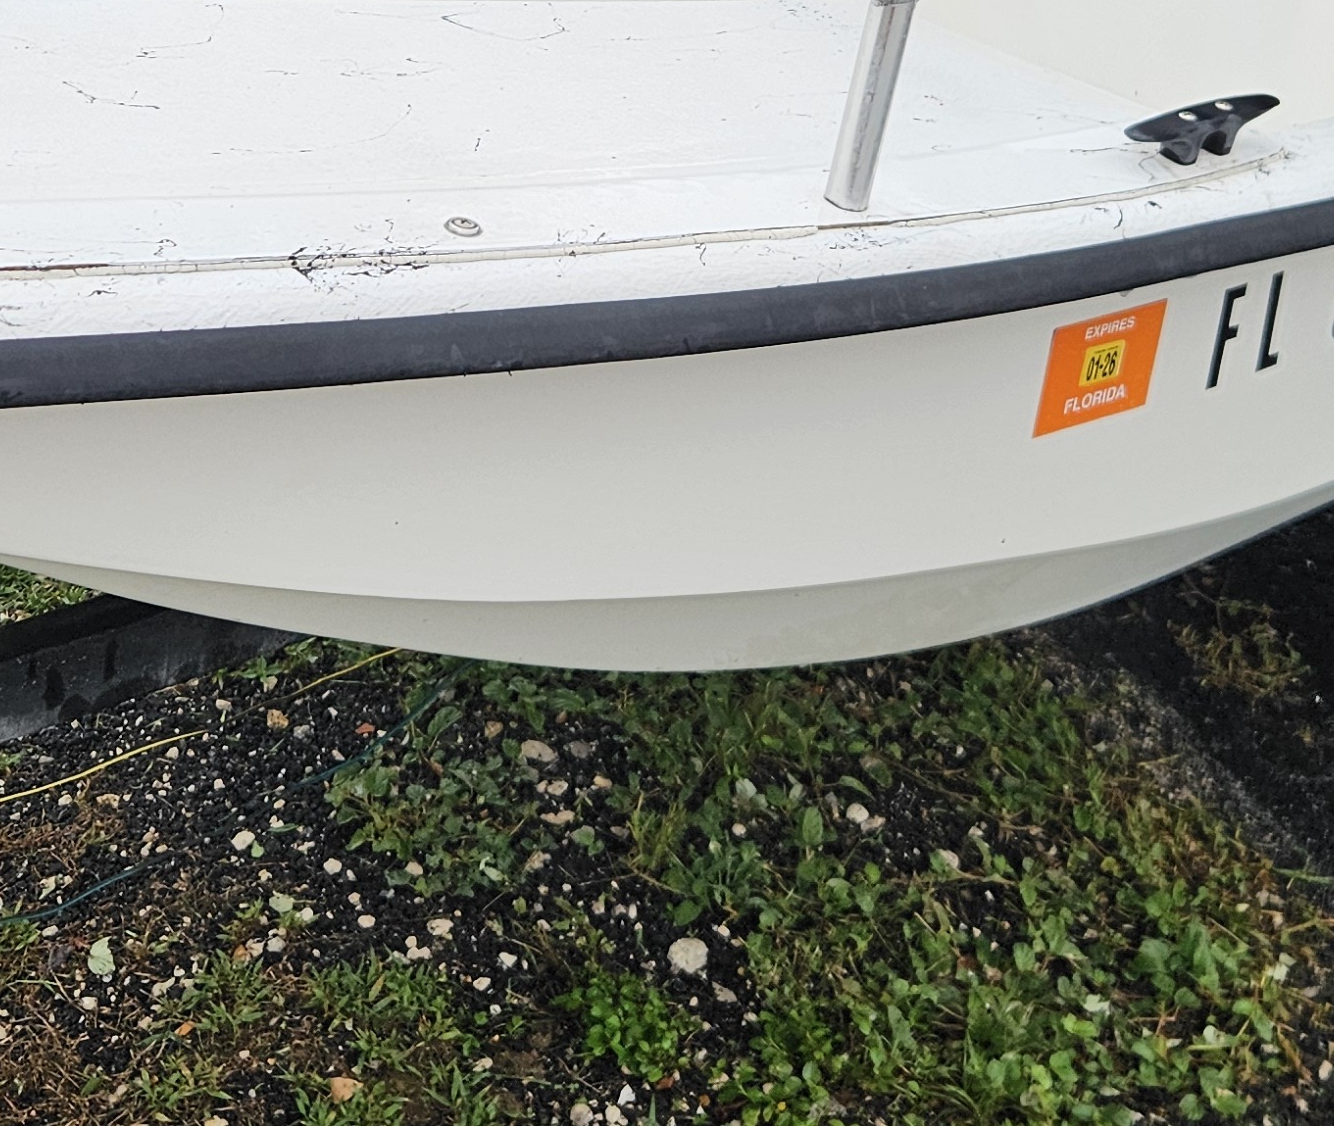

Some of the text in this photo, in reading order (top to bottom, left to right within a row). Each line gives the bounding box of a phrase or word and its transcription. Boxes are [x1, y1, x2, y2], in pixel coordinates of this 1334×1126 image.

[1084, 315, 1136, 341] EXPIRES
[1205, 269, 1284, 390] FL
[1085, 350, 1118, 382] 01-26
[1063, 383, 1126, 415] FLORIDA
